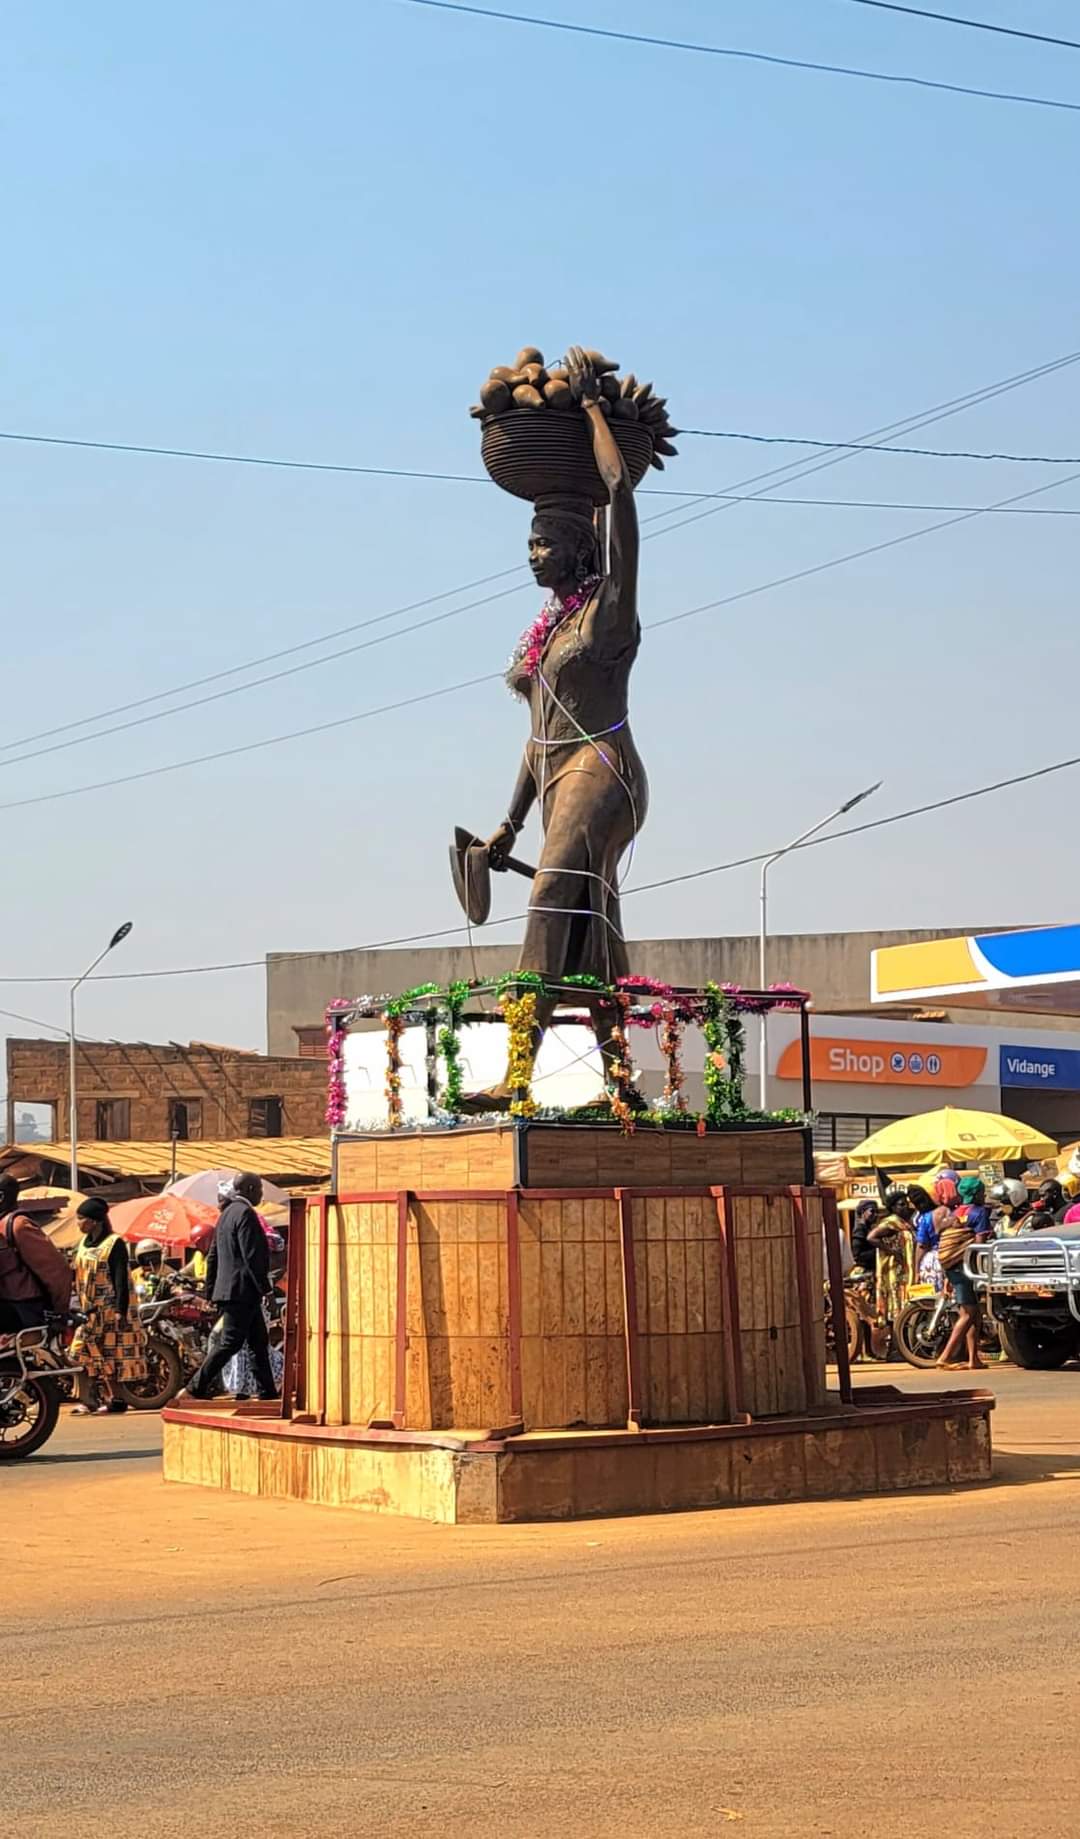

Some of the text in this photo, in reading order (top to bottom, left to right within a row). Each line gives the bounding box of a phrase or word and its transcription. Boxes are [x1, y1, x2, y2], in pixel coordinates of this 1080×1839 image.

[829, 1048, 884, 1078] Shop
[1007, 1058, 1056, 1078] Vidange
[851, 1183, 879, 1195] Poin
